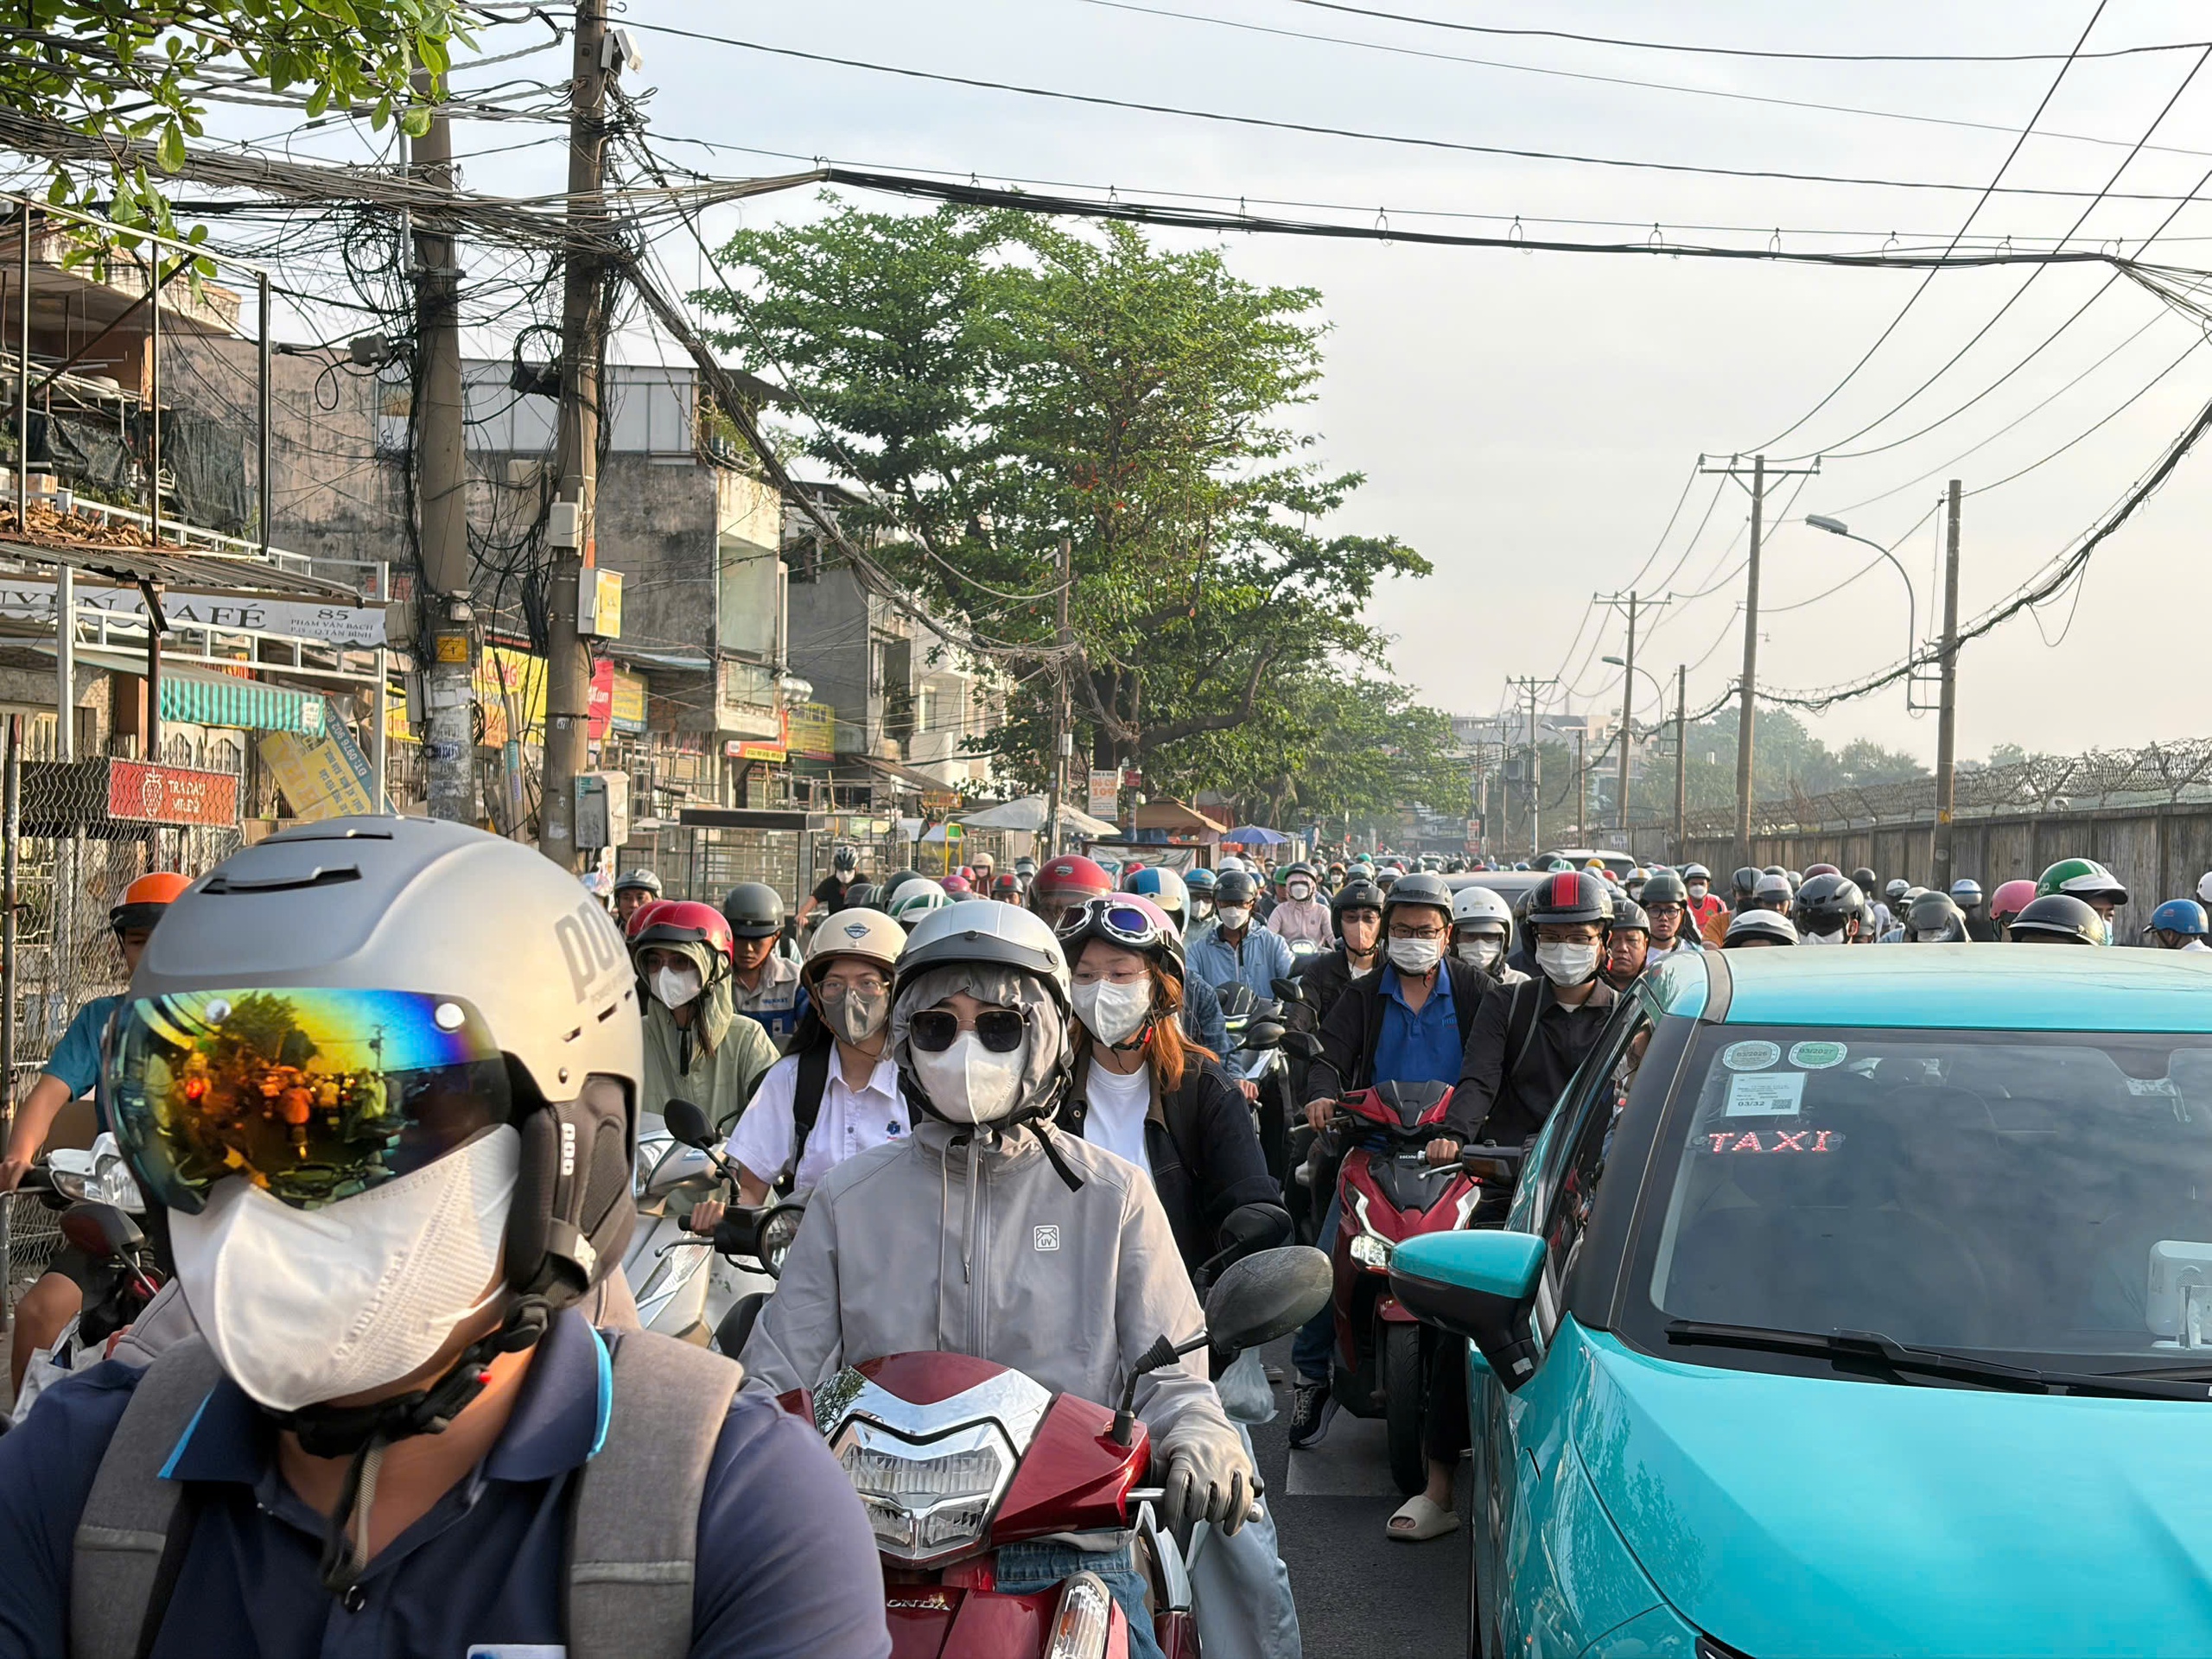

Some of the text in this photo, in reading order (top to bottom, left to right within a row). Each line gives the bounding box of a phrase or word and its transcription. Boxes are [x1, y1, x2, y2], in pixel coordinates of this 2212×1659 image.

[317, 608, 349, 620] 85
[331, 725, 346, 741] 902
[340, 739, 358, 761] 0976
[1091, 787, 1116, 797] 109
[1709, 1130, 1833, 1153] TAXI
[887, 1597, 951, 1611] ONDA
